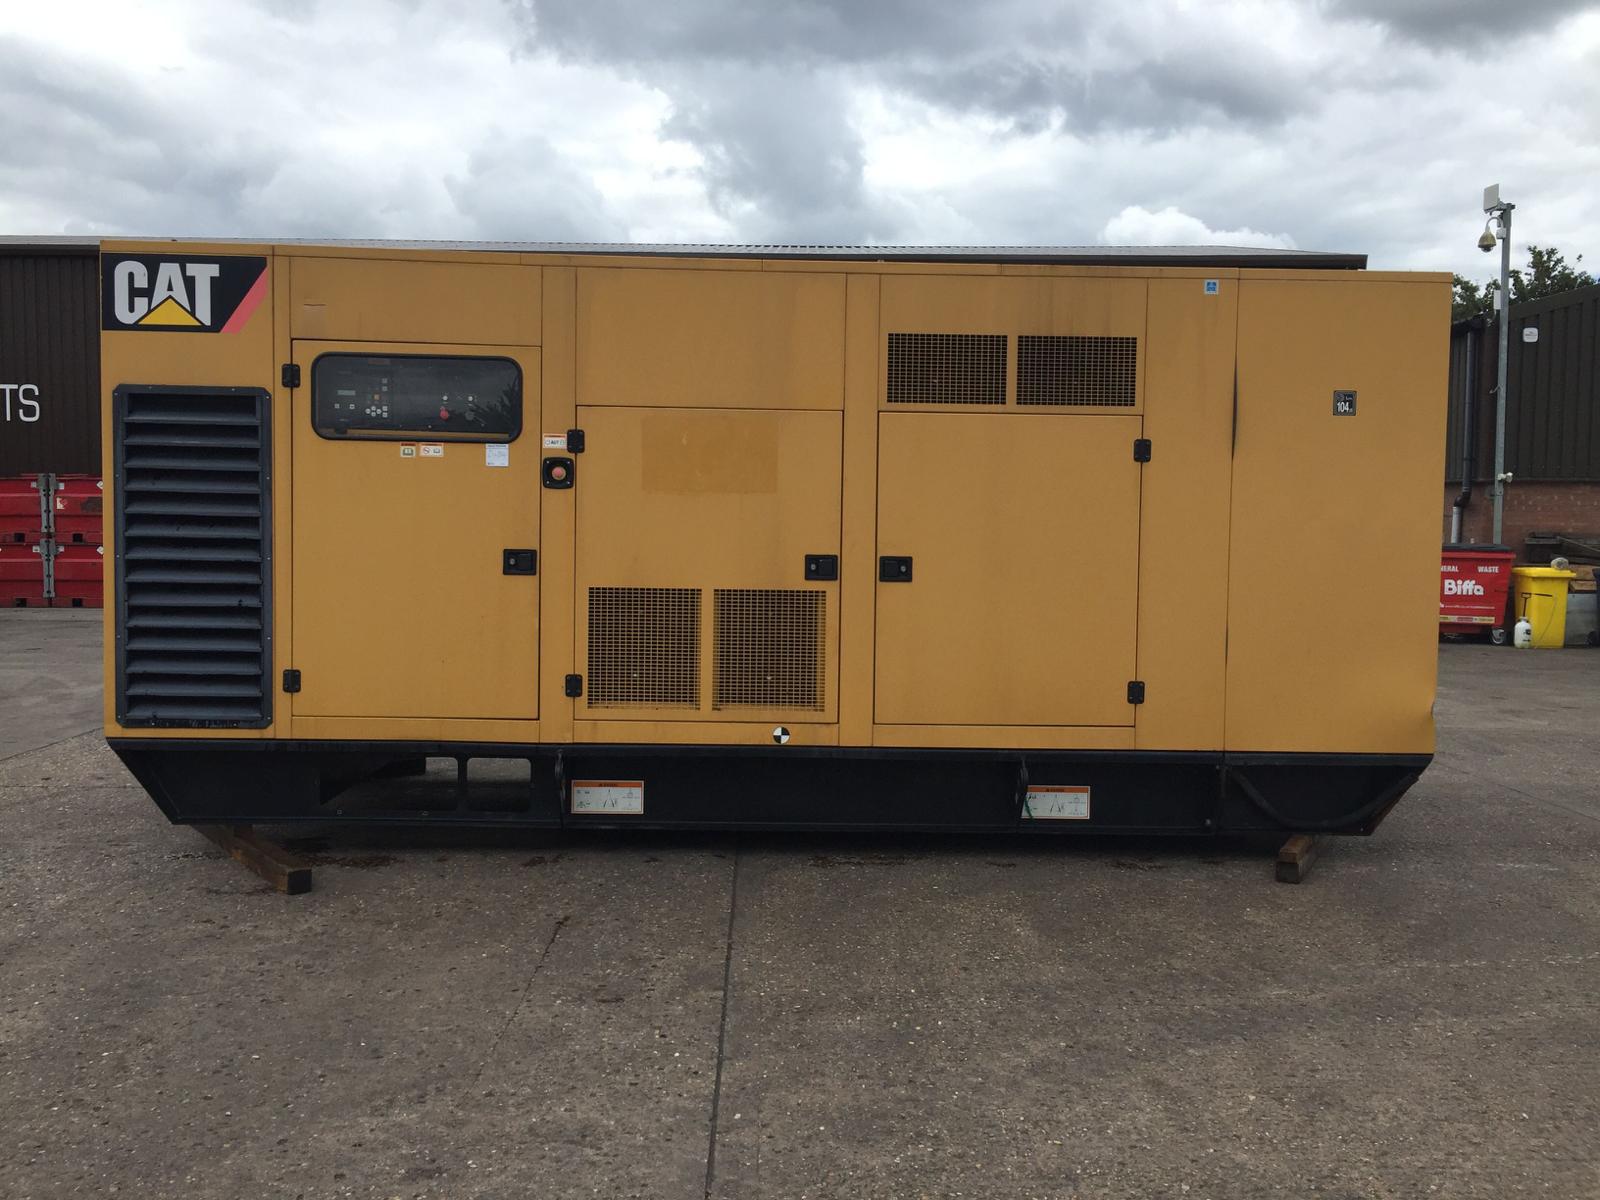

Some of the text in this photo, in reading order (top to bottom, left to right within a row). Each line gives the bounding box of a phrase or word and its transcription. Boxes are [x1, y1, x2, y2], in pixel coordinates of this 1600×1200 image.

[114, 260, 220, 326] CAT
[0, 384, 40, 422] TS
[1337, 401, 1349, 412] 104
[1444, 579, 1484, 596] Biffa
